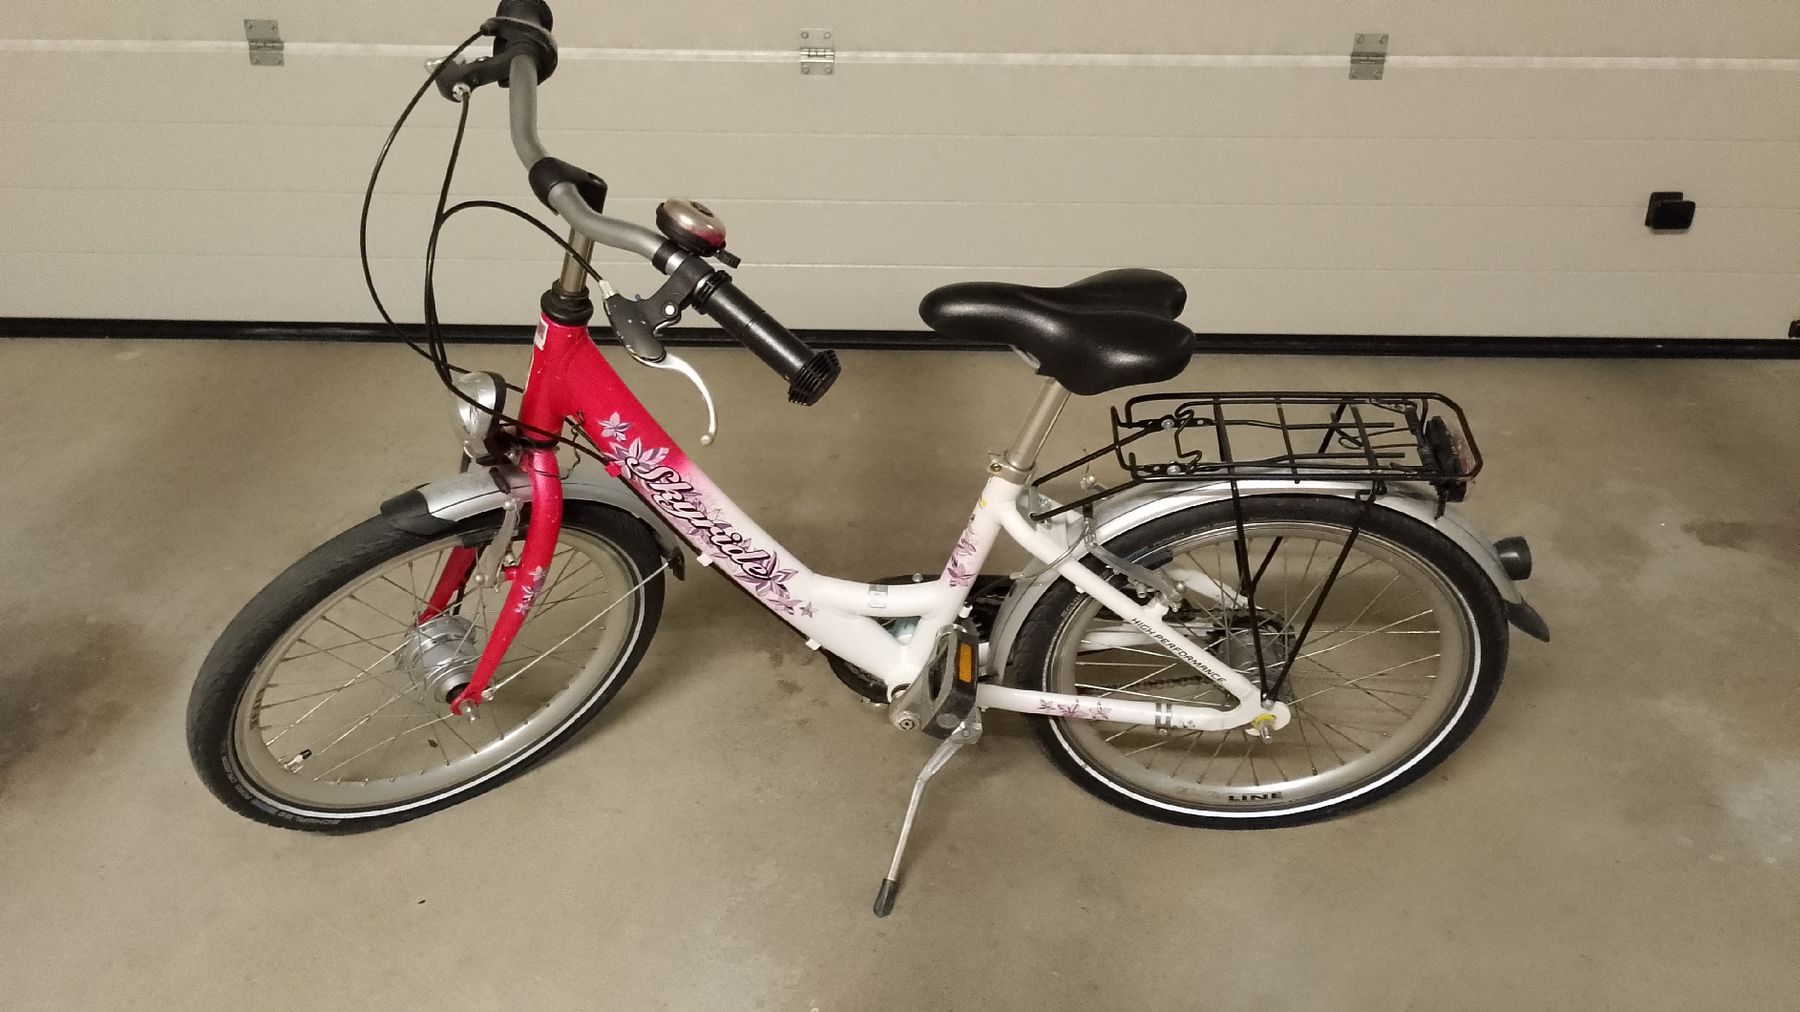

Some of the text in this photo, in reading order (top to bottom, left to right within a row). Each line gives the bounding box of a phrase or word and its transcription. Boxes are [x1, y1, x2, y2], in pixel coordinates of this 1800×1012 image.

[624, 456, 772, 580] Skyride
[1132, 617, 1228, 685] HIGH PERFORMANCE
[1228, 791, 1283, 802] LINE
